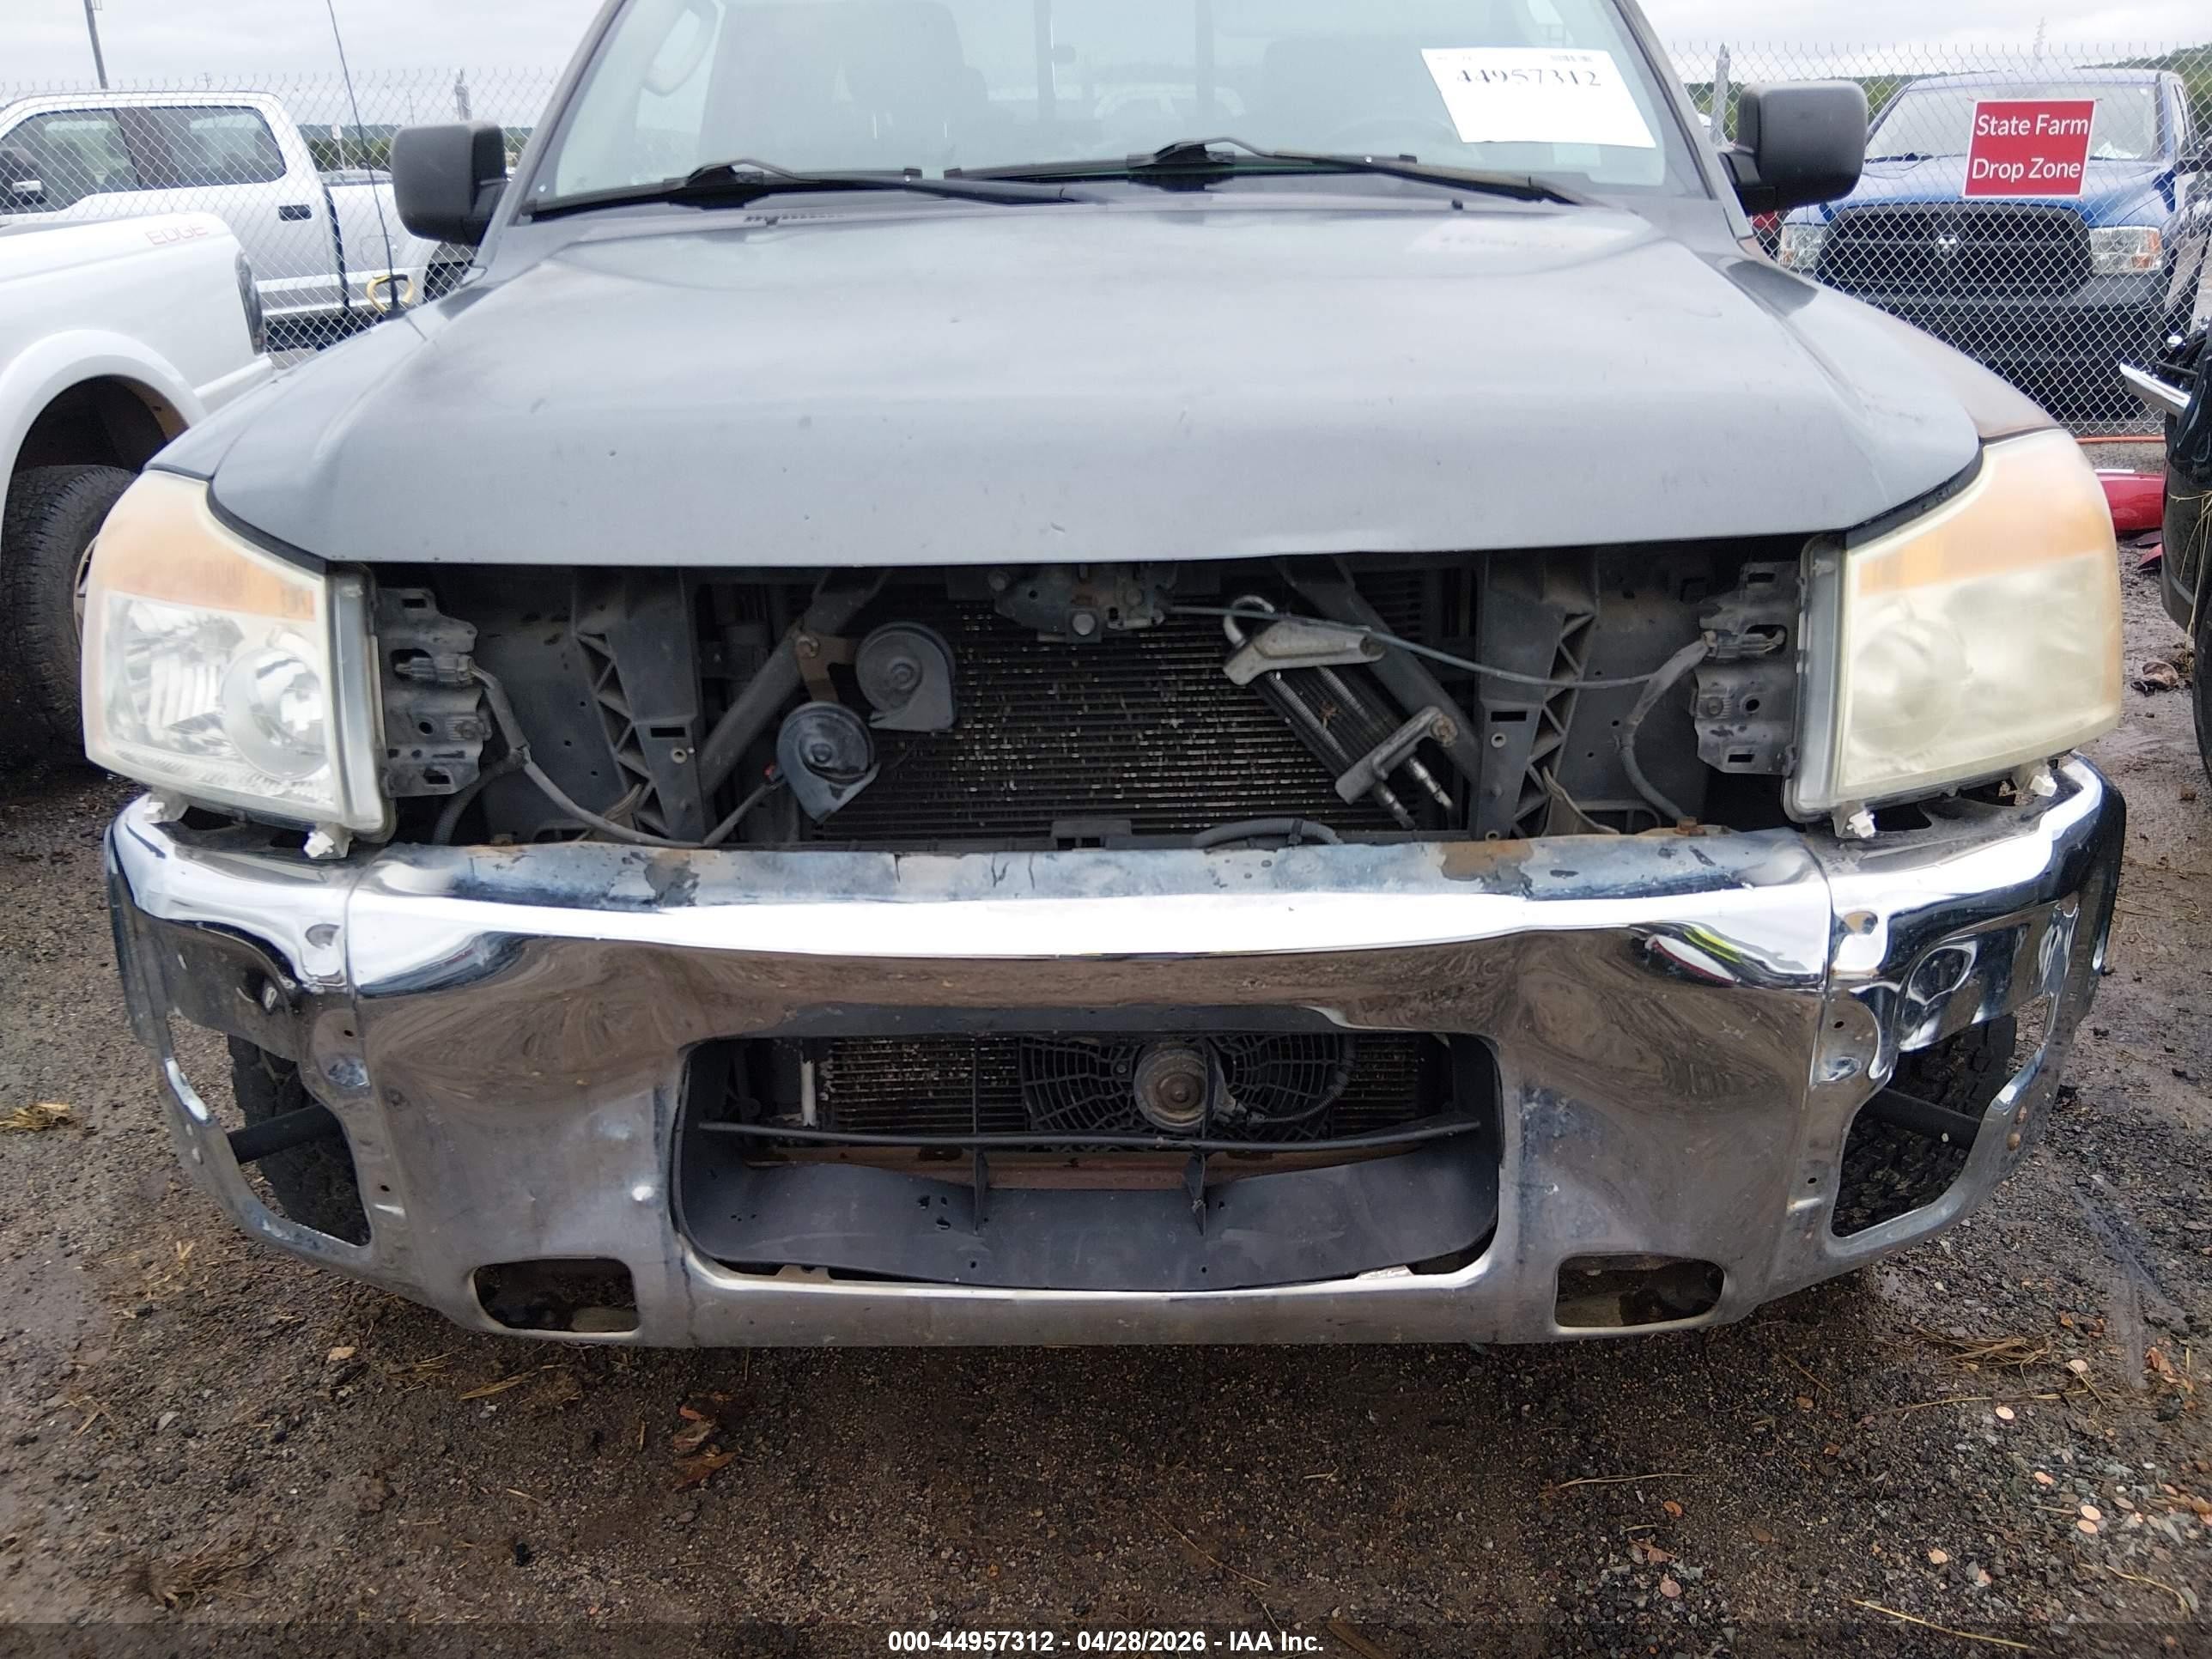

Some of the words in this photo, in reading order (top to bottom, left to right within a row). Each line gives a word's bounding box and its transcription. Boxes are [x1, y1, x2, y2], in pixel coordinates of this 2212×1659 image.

[1976, 114, 2031, 136] State
[2035, 113, 2089, 136] Farm
[1972, 158, 2024, 183] Drop
[2028, 157, 2081, 179] Zone
[144, 225, 209, 246] EDGE
